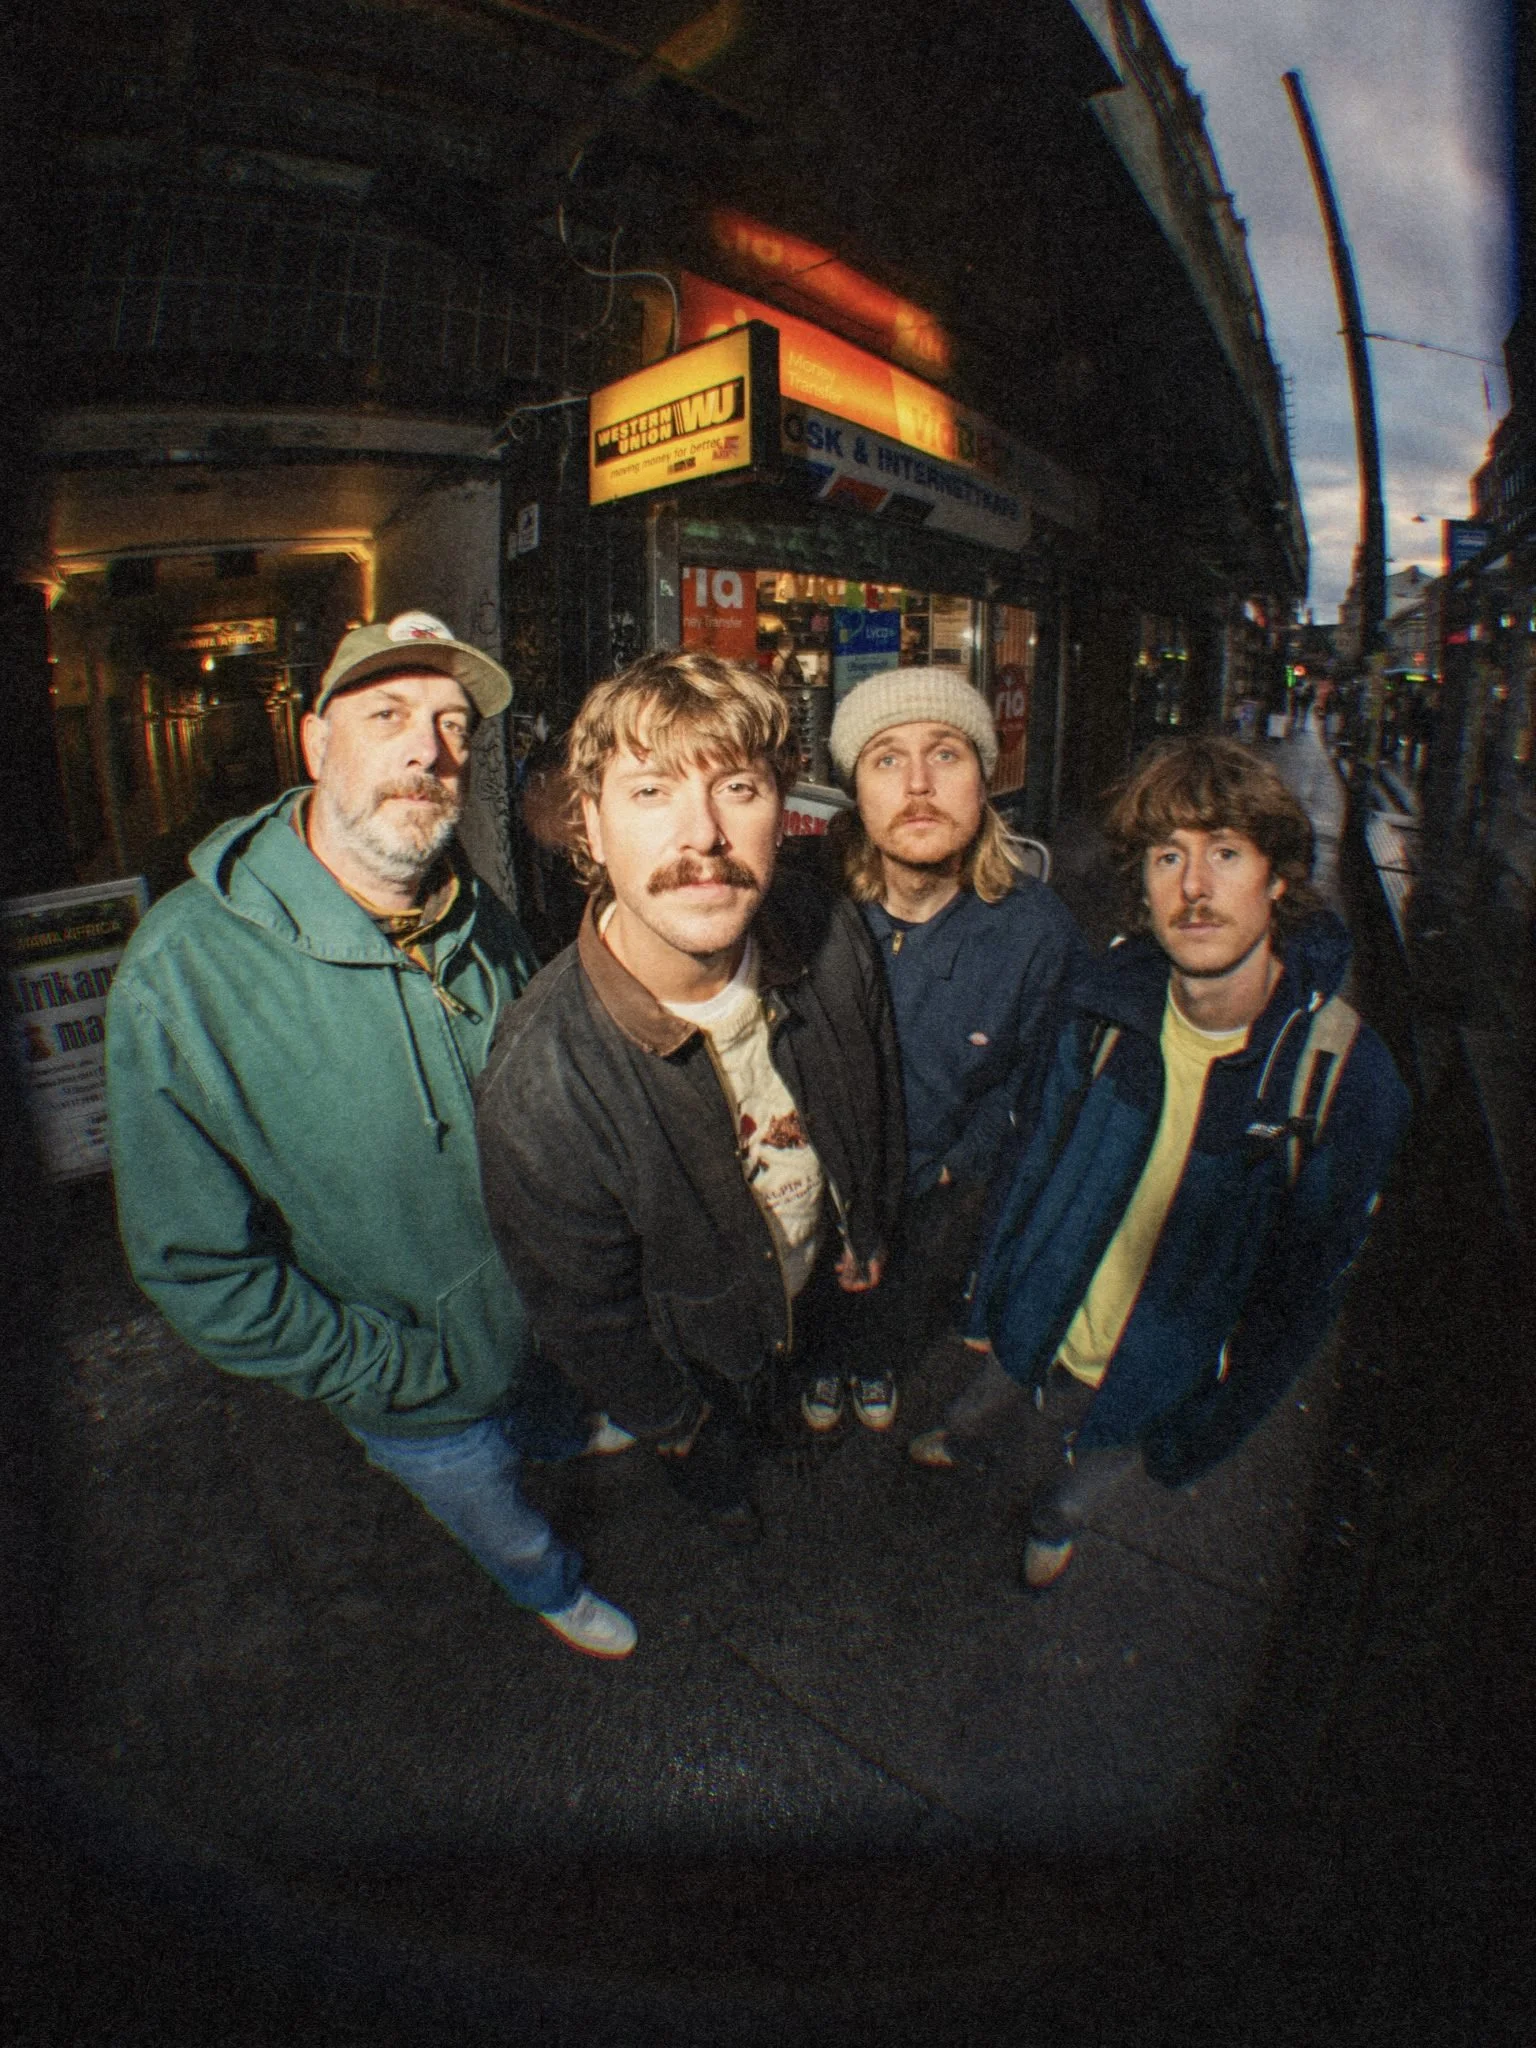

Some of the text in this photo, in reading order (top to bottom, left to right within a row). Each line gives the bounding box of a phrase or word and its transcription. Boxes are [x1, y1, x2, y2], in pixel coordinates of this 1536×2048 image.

[597, 405, 672, 447] WESTERN
[681, 383, 735, 433] WU
[609, 462, 641, 479] moving
[642, 452, 672, 470] money
[674, 447, 688, 459] for
[690, 437, 723, 455] better
[618, 422, 672, 455] UNION
[854, 433, 871, 468] &
[56, 1014, 107, 1053] ma
